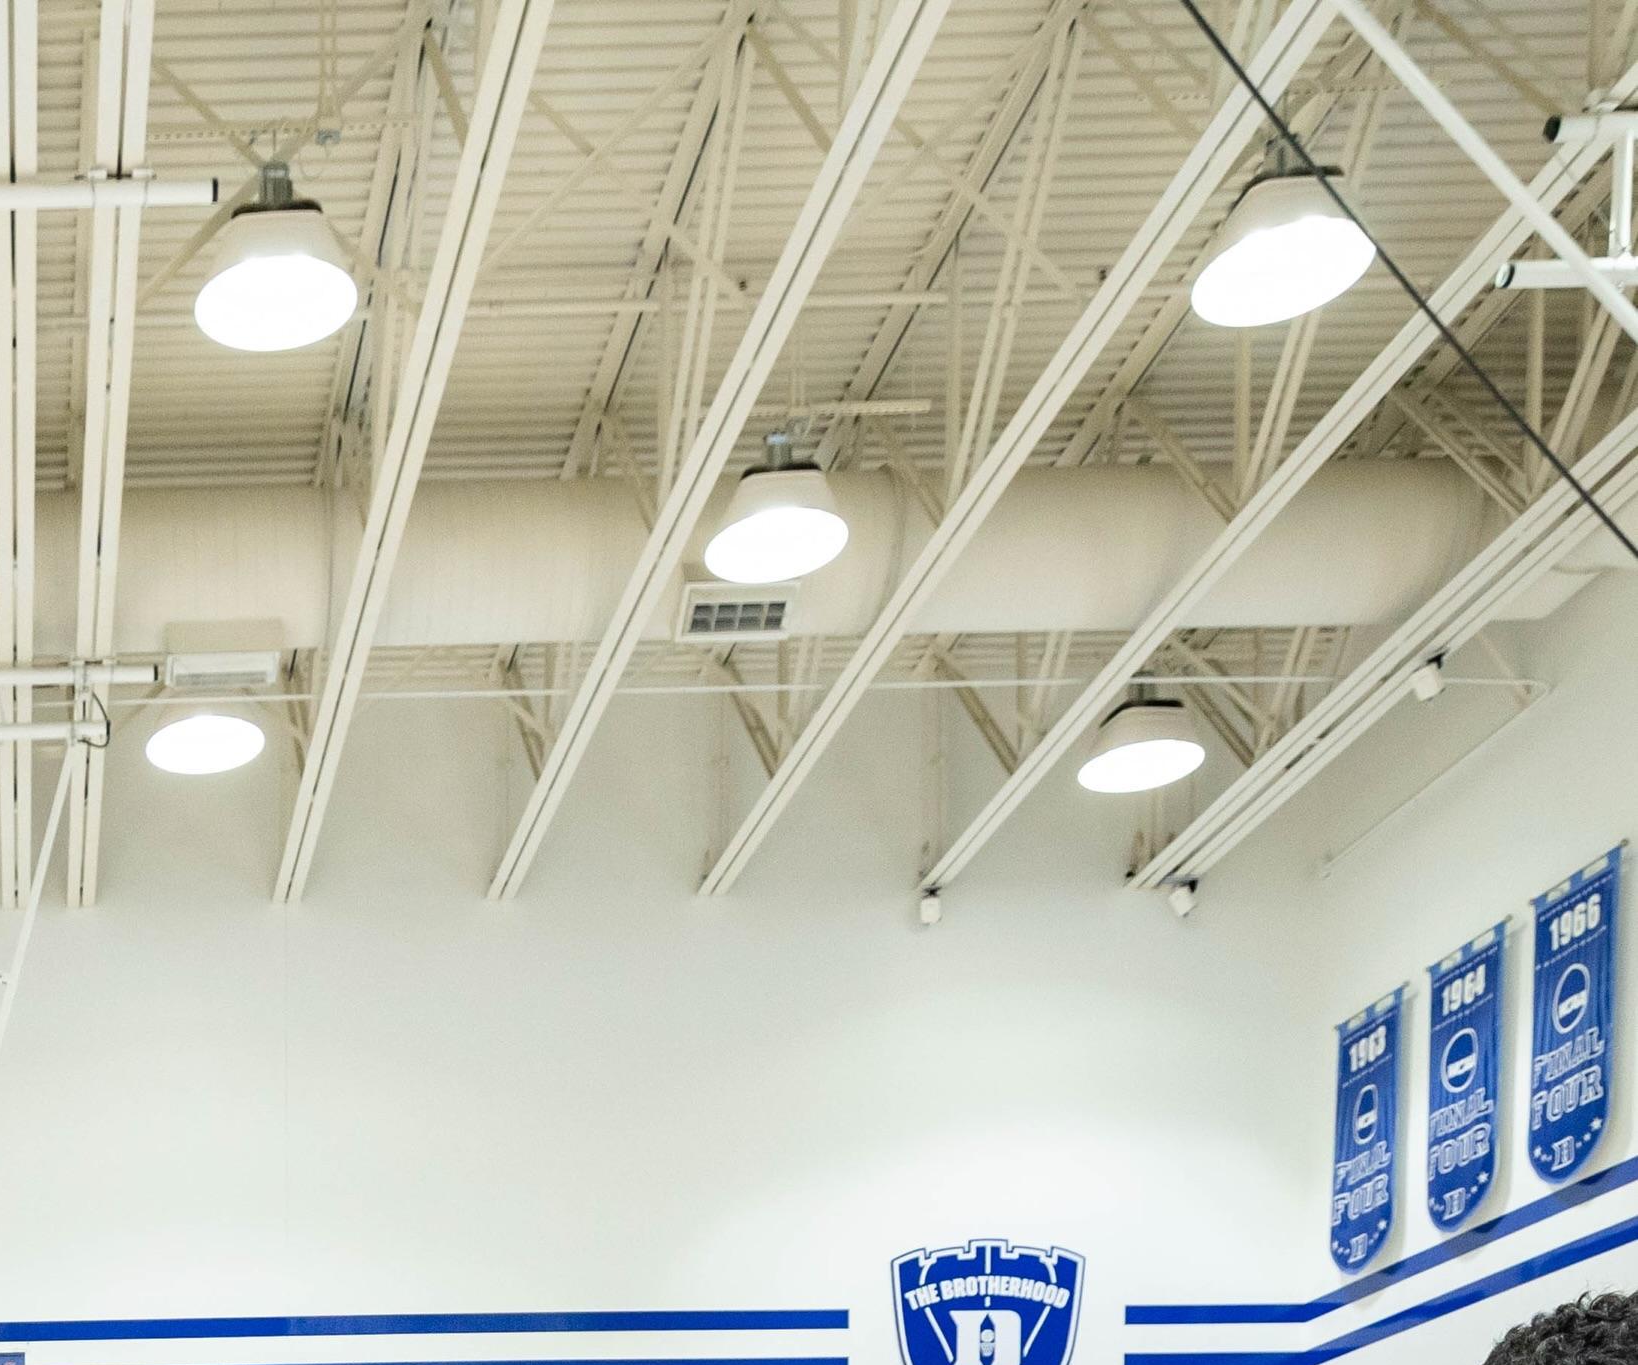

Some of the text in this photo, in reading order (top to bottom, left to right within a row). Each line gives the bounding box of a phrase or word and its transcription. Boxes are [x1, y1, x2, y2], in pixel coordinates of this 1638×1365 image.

[1548, 893, 1602, 951] 1966
[1441, 964, 1486, 1016] 1964
[1533, 1026, 1605, 1088] FINAL
[1429, 1086, 1494, 1141] FINAL
[1532, 1064, 1604, 1131] FOUR
[1428, 1121, 1492, 1181] FOUR
[1332, 1173, 1389, 1226] FOUR
[904, 1275, 1071, 1311] THE BROTHERHOOD
